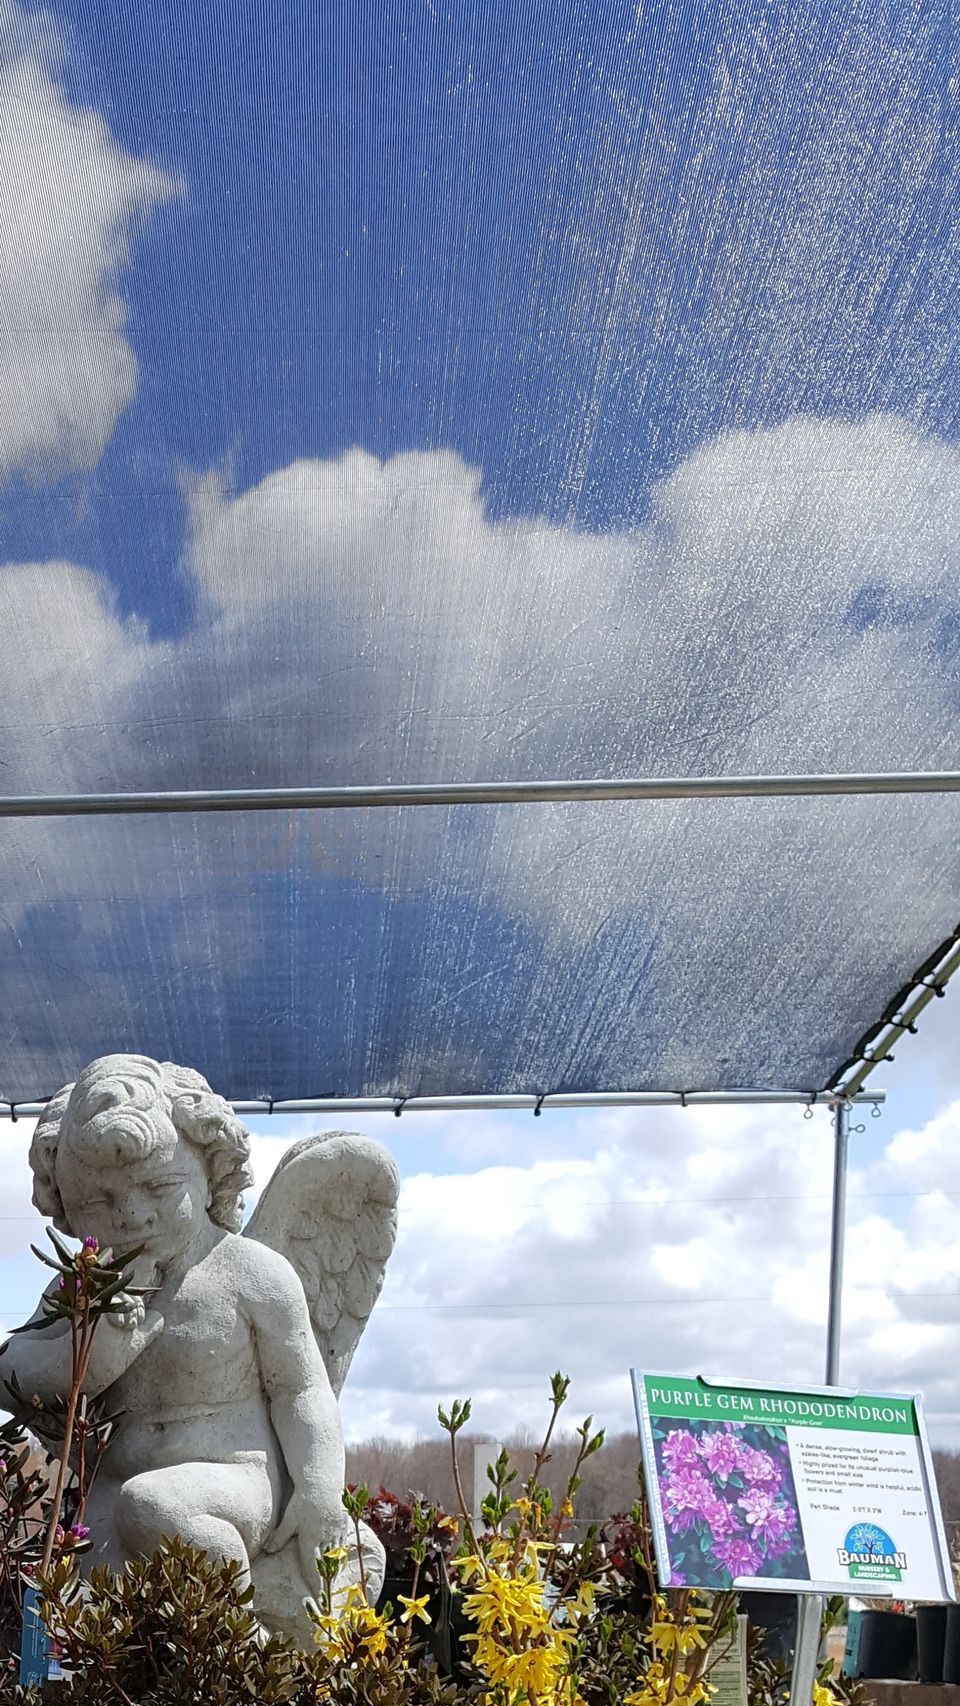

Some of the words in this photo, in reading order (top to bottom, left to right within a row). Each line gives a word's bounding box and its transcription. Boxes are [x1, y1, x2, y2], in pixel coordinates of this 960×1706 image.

[650, 1388, 712, 1407] PURPLE
[717, 1394, 754, 1411] GEM
[760, 1398, 907, 1423] RHODODENDRON
[802, 1460, 820, 1468] Highly
[878, 1466, 913, 1474] purplish-blue
[804, 1468, 824, 1476] flowers
[837, 1548, 907, 1569] BAUMAN
[858, 1565, 885, 1573] NURSERY
[854, 1571, 897, 1579] LANDSCAPING
